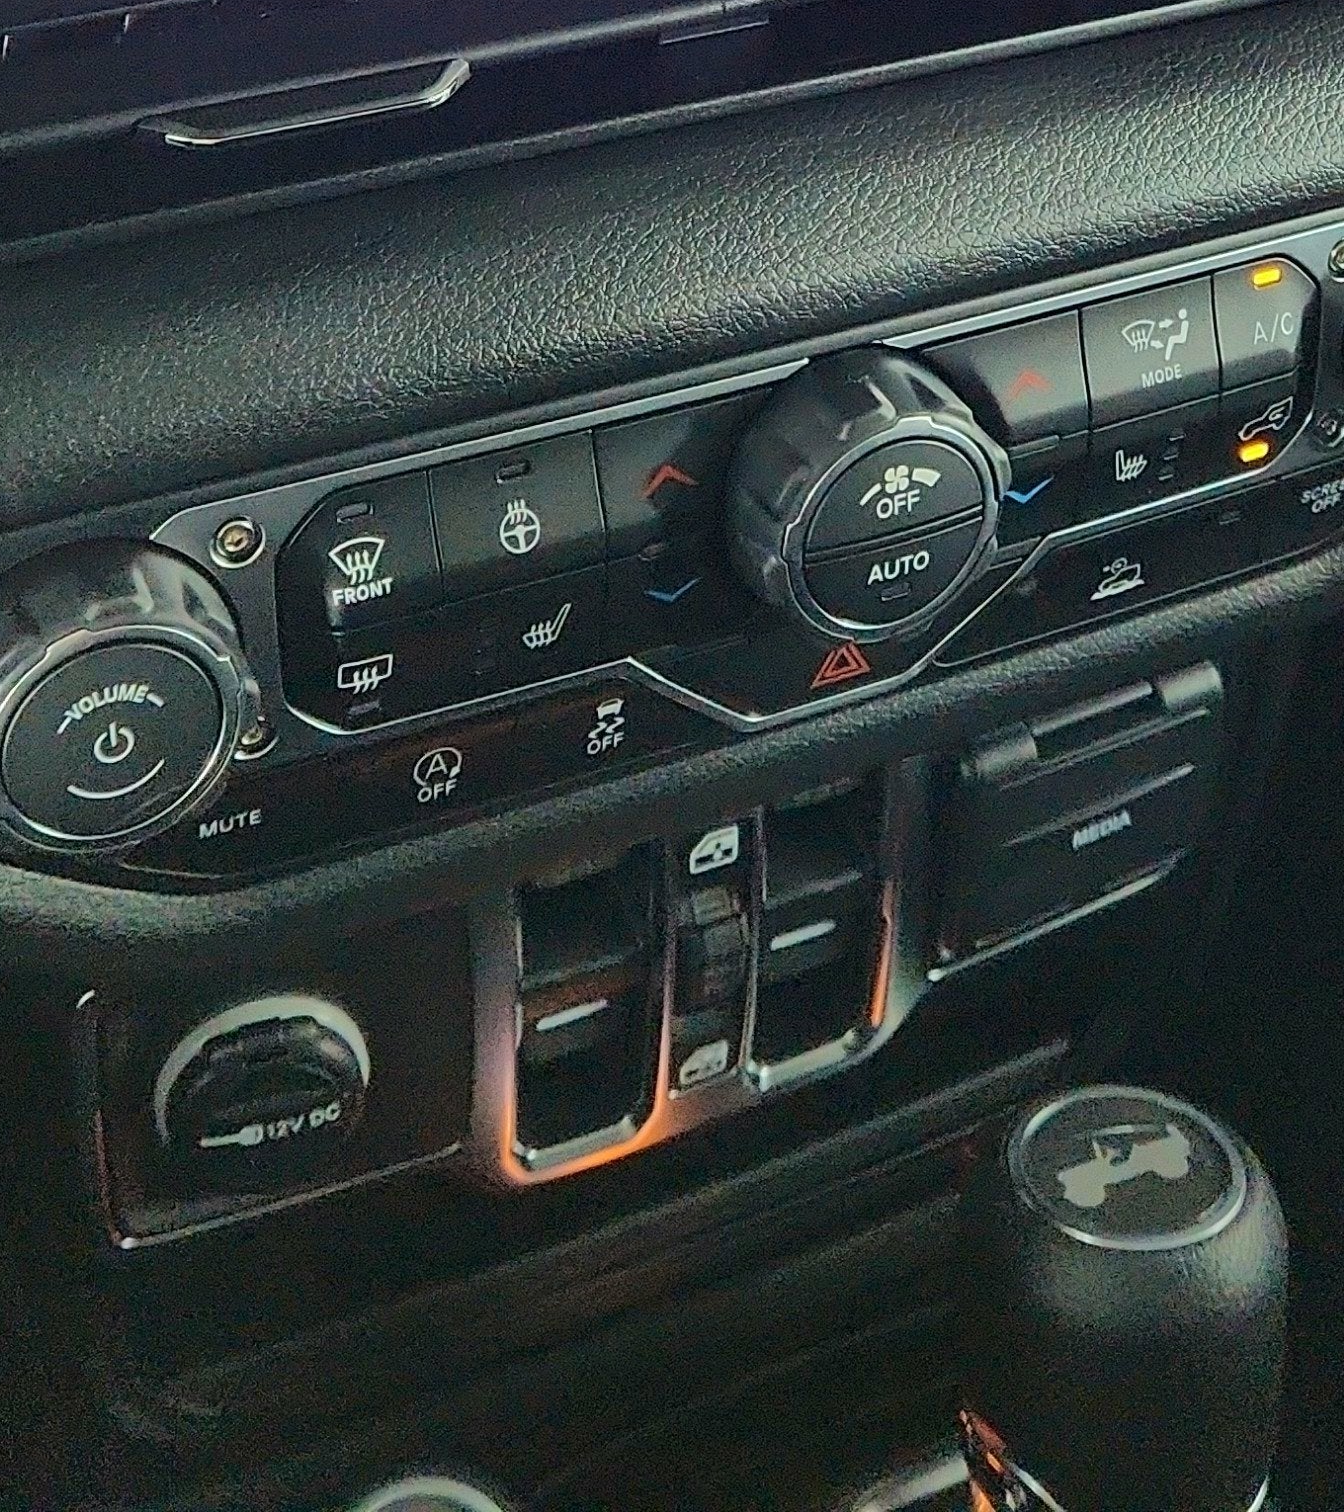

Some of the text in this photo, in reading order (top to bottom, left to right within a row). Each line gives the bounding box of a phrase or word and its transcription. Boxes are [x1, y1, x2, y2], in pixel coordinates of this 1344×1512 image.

[1252, 313, 1294, 345] A/C
[1141, 363, 1183, 388] MODE
[875, 490, 921, 520] OFF
[867, 550, 931, 585] AUTO
[331, 577, 394, 607] FRONT
[64, 684, 151, 722] VOLUME
[586, 730, 625, 755] OFF
[416, 778, 458, 803] OFF
[198, 808, 262, 839] MUTE
